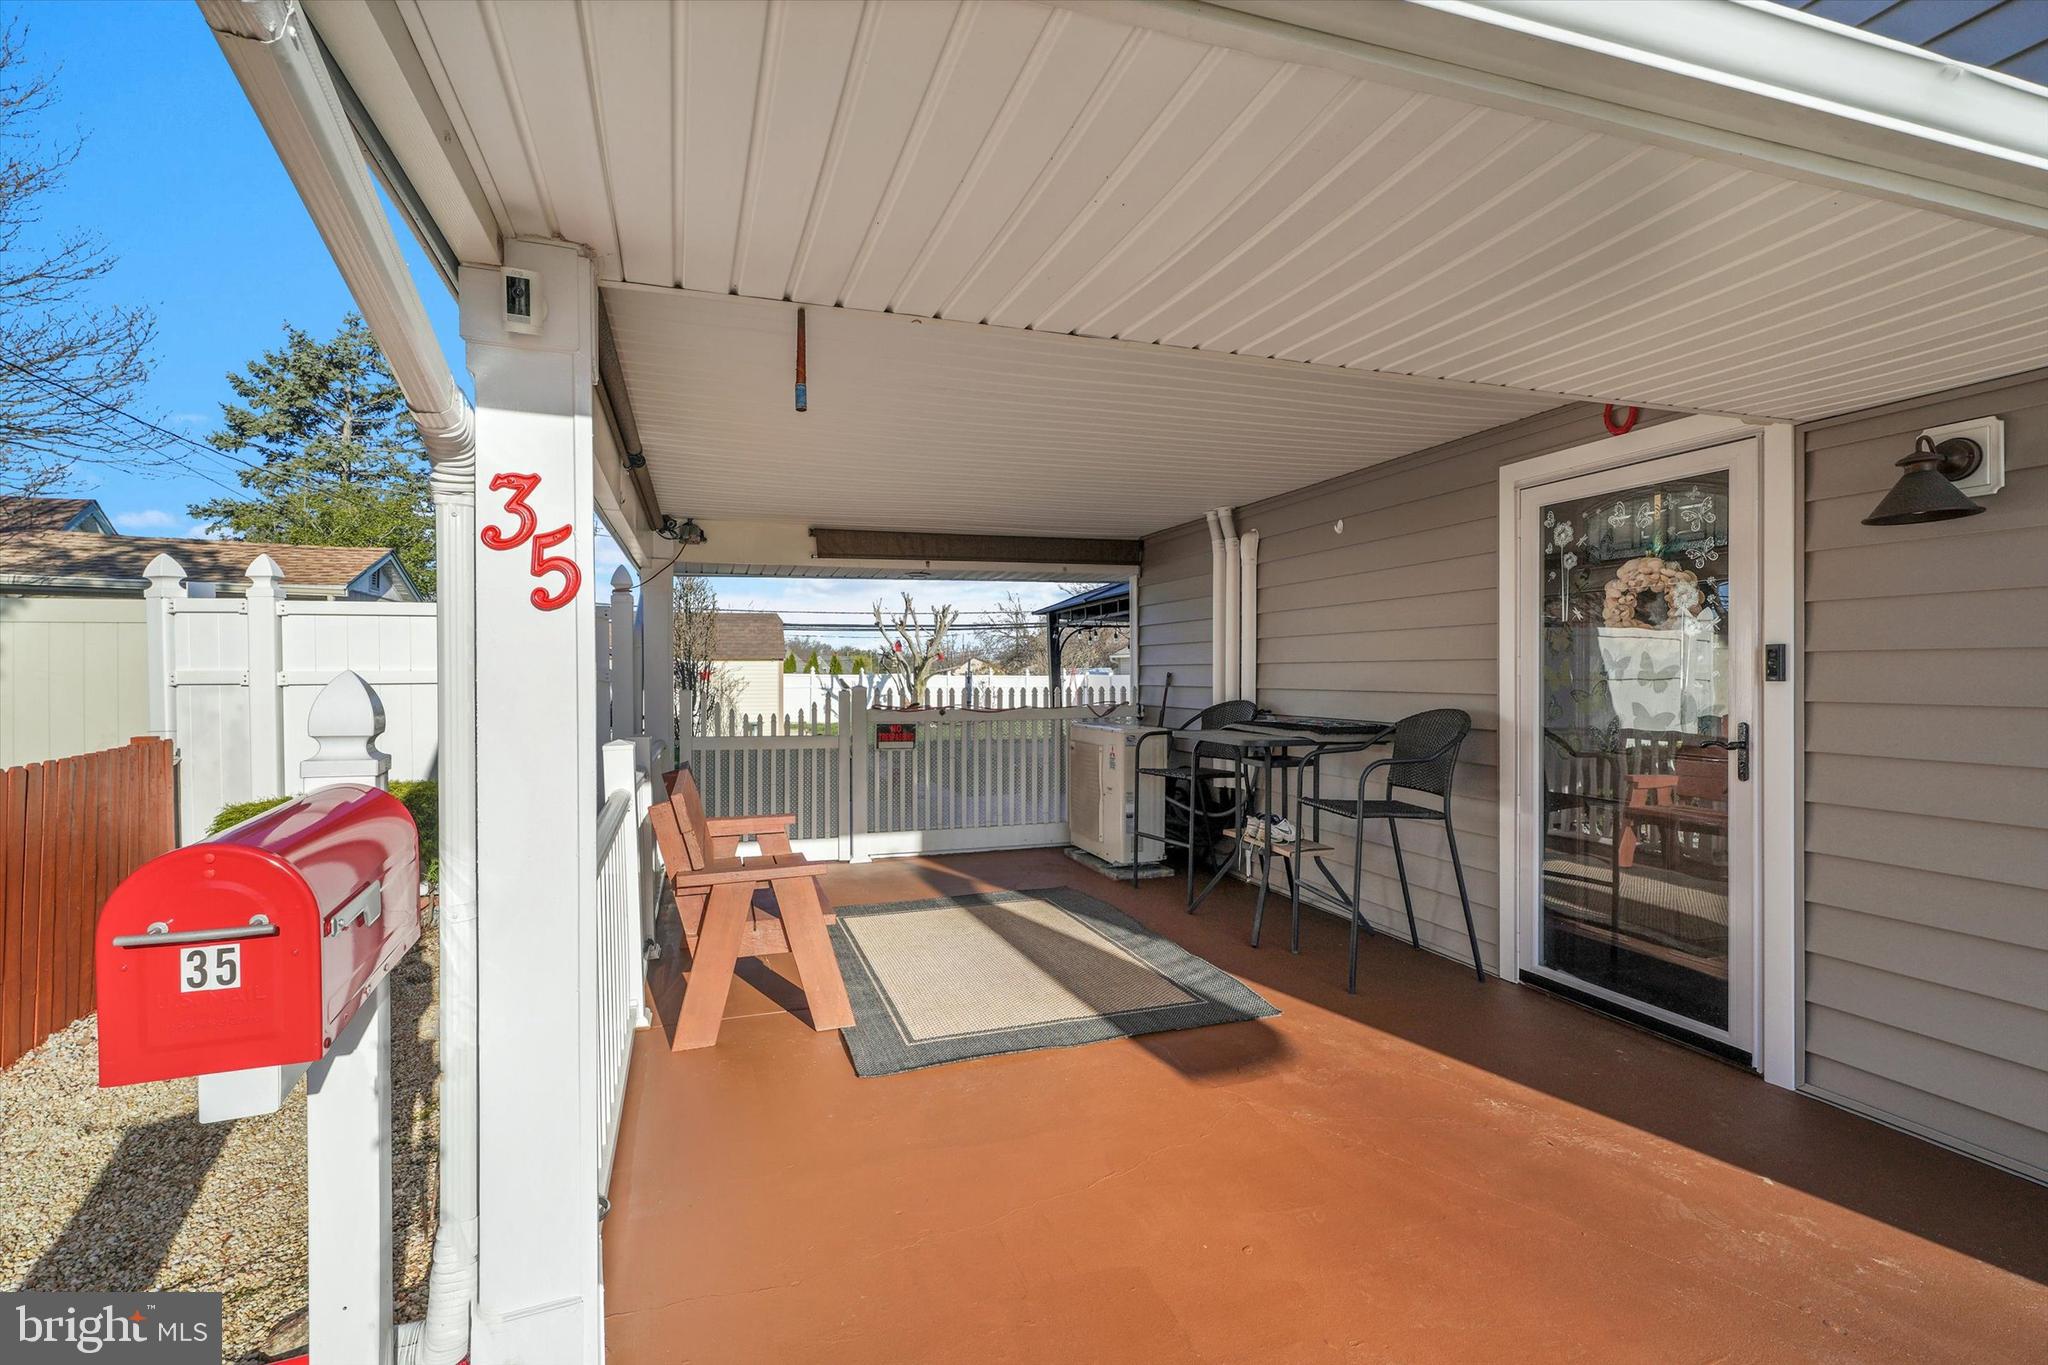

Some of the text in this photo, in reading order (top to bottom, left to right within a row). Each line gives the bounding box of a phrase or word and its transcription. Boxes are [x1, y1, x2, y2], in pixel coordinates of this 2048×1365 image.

[480, 472, 582, 611] 35
[889, 724, 902, 733] NO
[186, 947, 237, 989] 35
